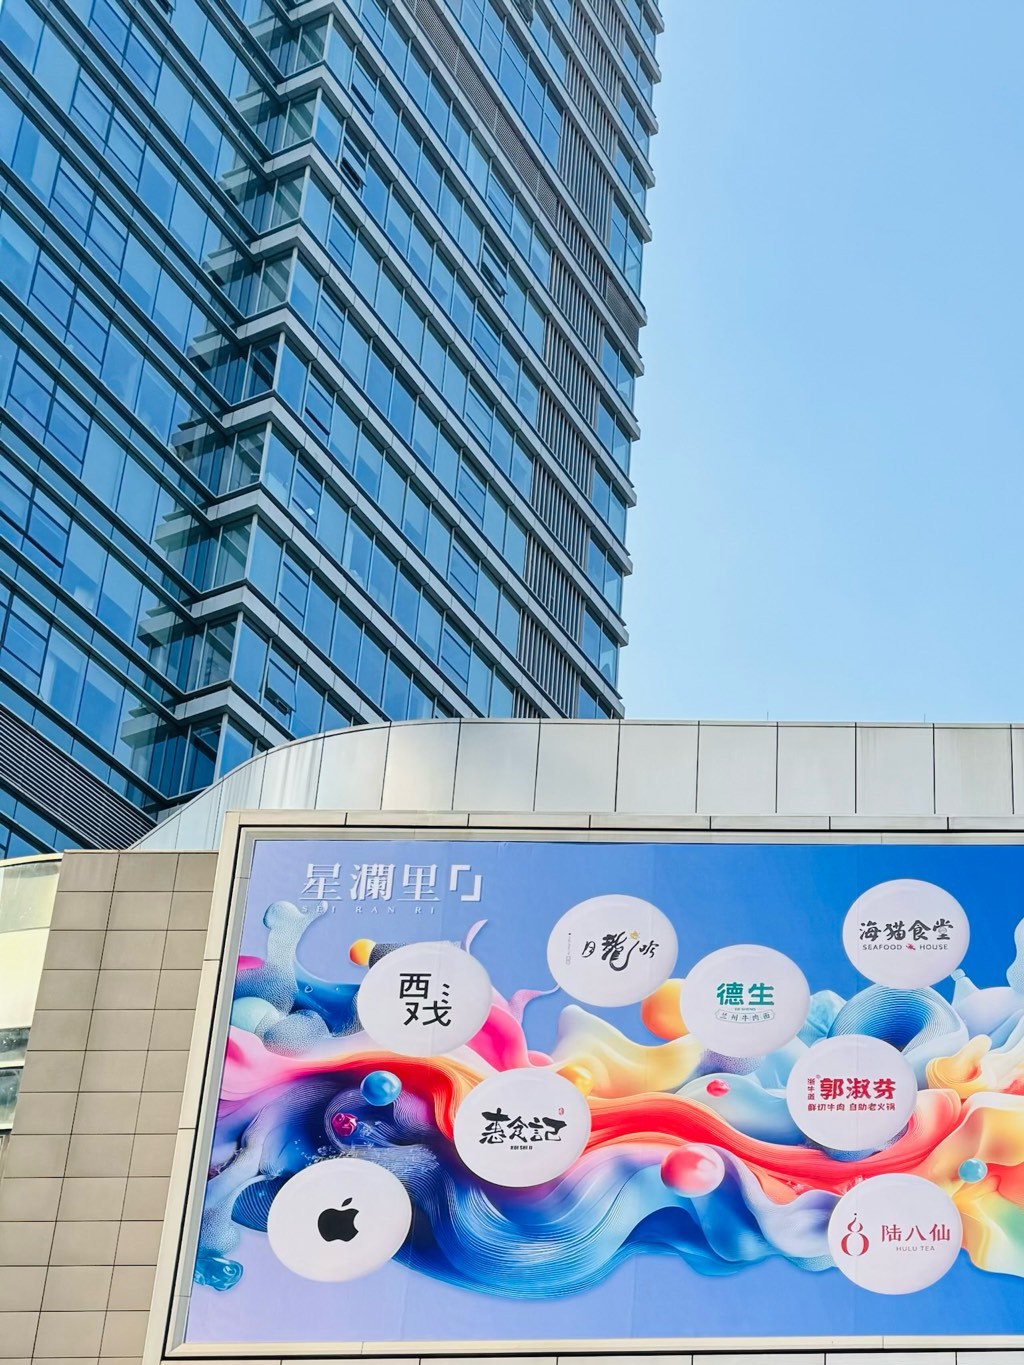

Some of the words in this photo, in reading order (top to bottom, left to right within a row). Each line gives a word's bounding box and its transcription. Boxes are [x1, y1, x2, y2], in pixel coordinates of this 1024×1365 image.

[302, 906, 336, 914] SEI
[355, 906, 395, 914] RAN
[415, 906, 435, 914] RI
[860, 919, 954, 941] 海猫食堂
[716, 981, 775, 1006] 德生
[820, 1077, 896, 1100] 郭淑芬
[881, 1223, 951, 1242] 陆八仙
